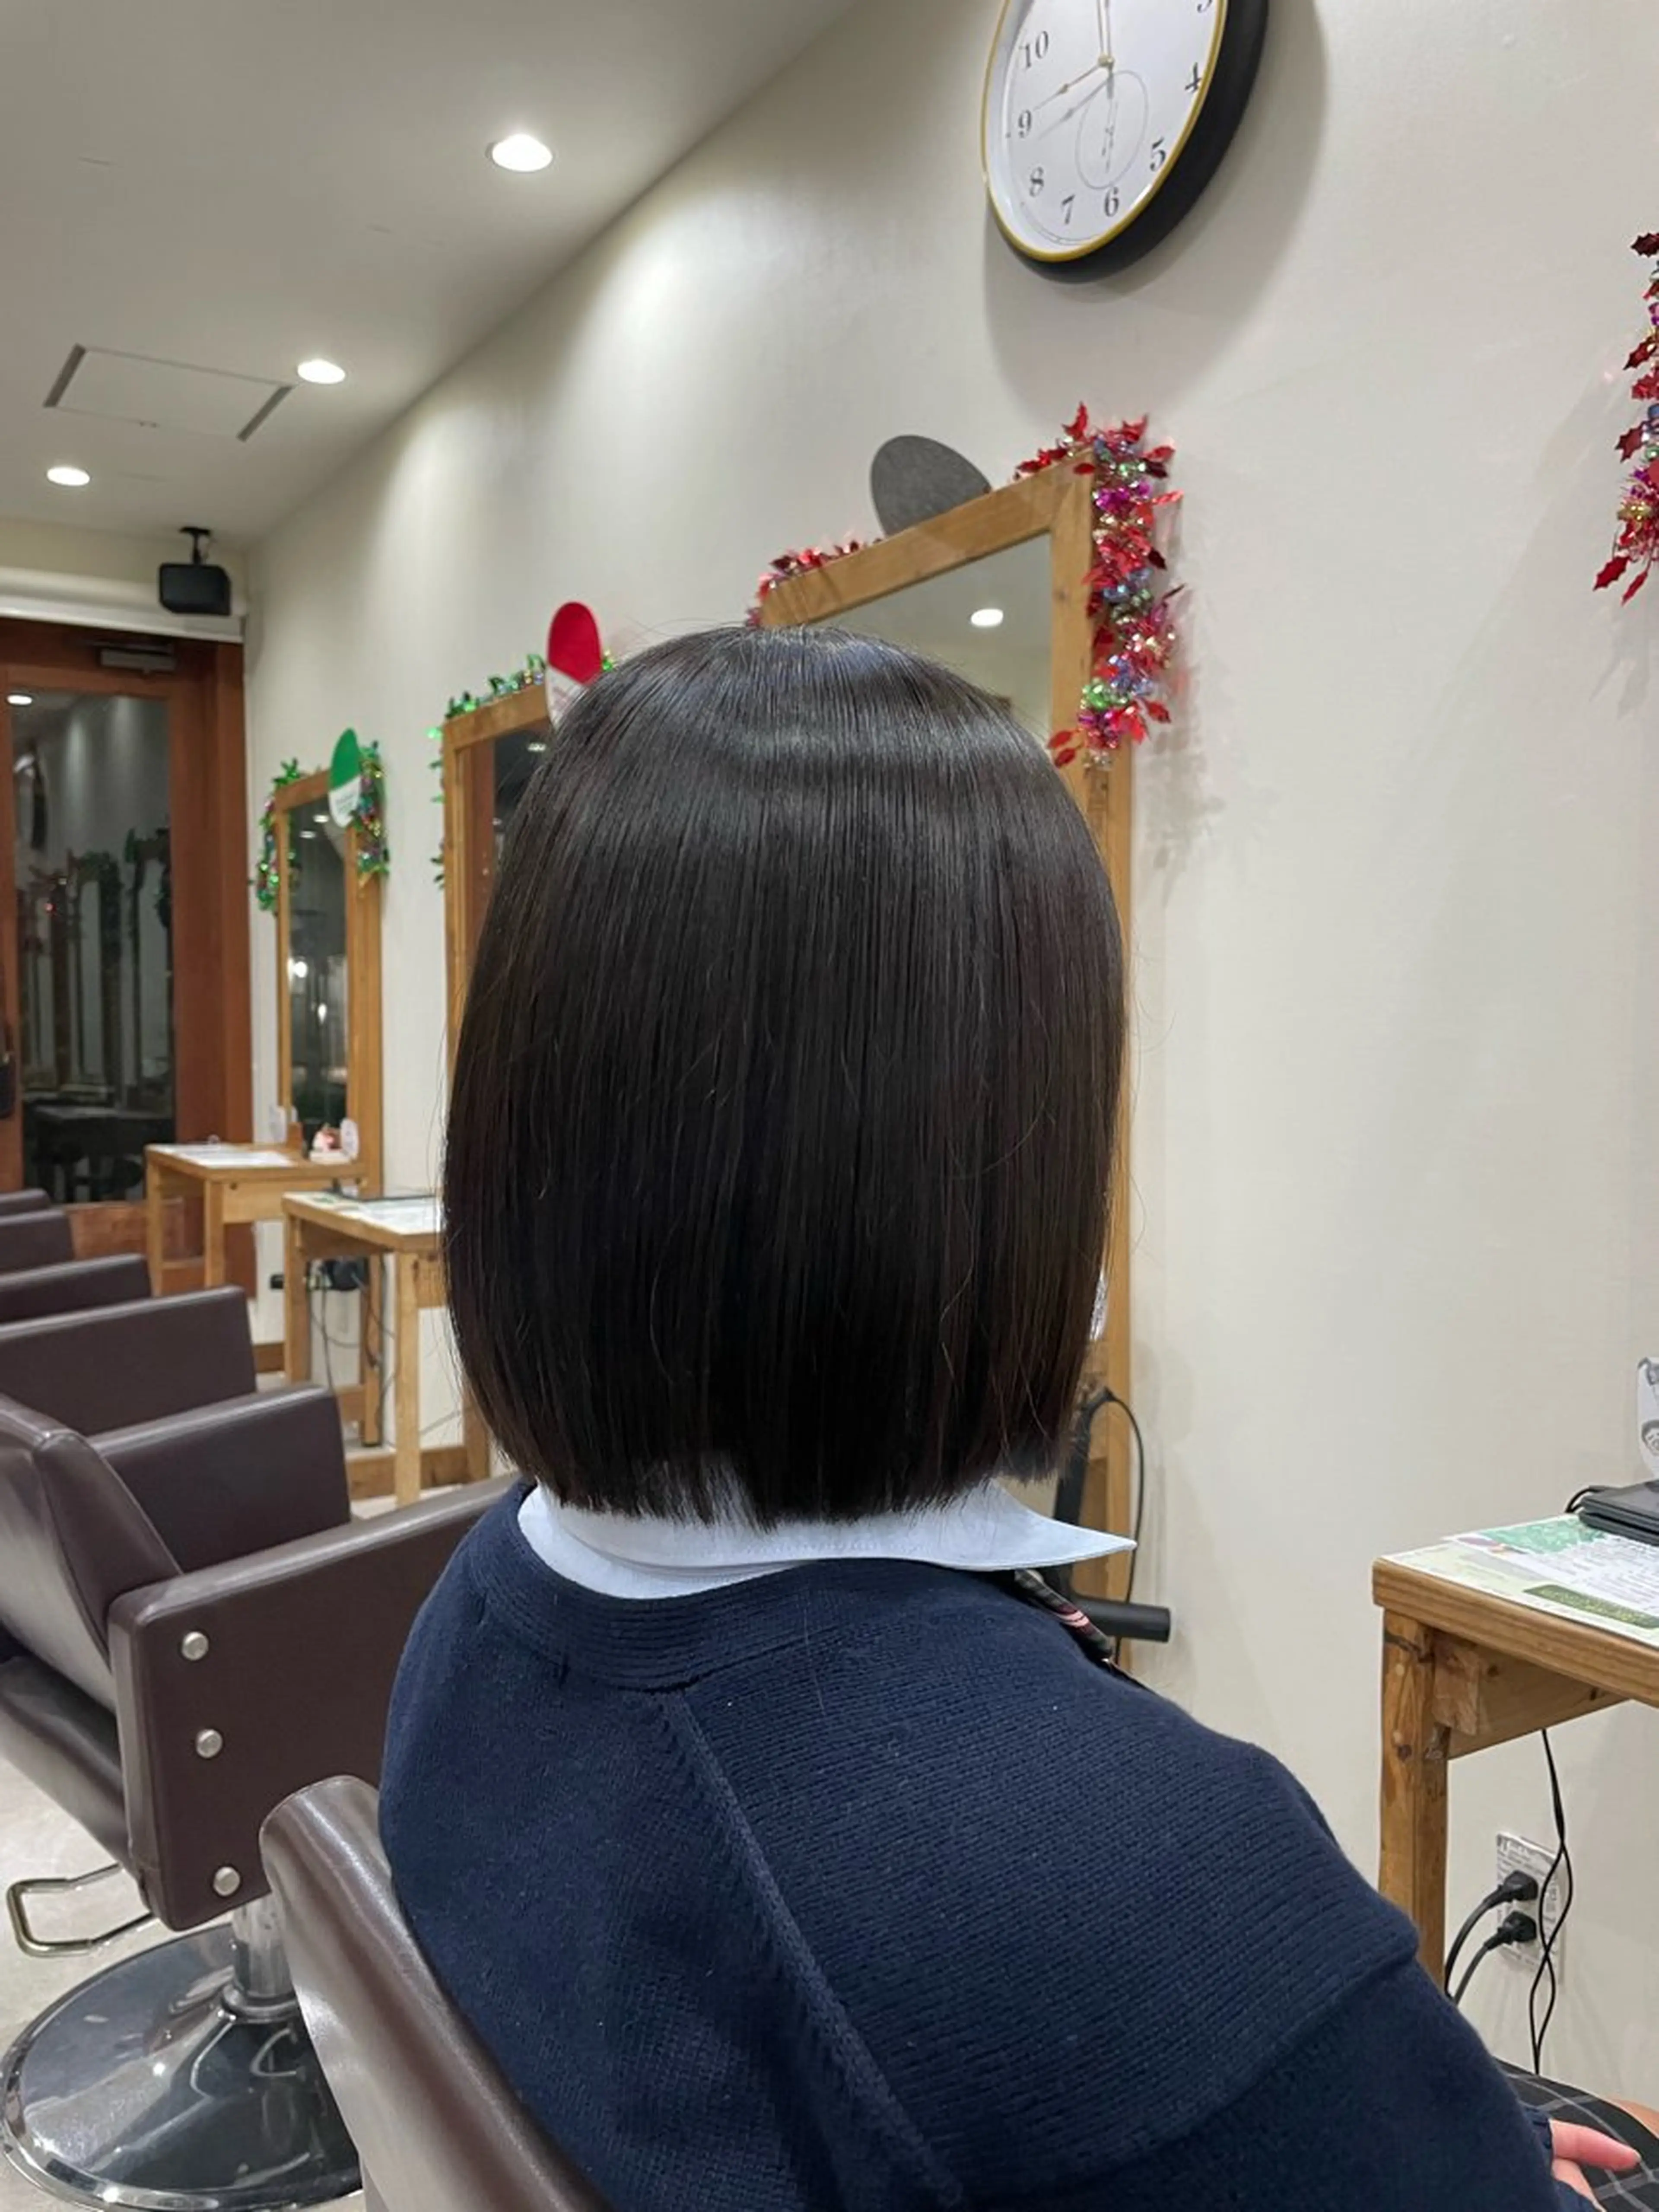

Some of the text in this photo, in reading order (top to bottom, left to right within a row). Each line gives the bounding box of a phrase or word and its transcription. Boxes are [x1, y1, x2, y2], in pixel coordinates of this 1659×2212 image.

[1018, 31, 1049, 68] 10
[1018, 110, 1032, 139] 9
[1150, 137, 1166, 172] 5
[1029, 166, 1044, 197] 8
[1061, 194, 1075, 224] 7
[1104, 186, 1119, 217] 6
